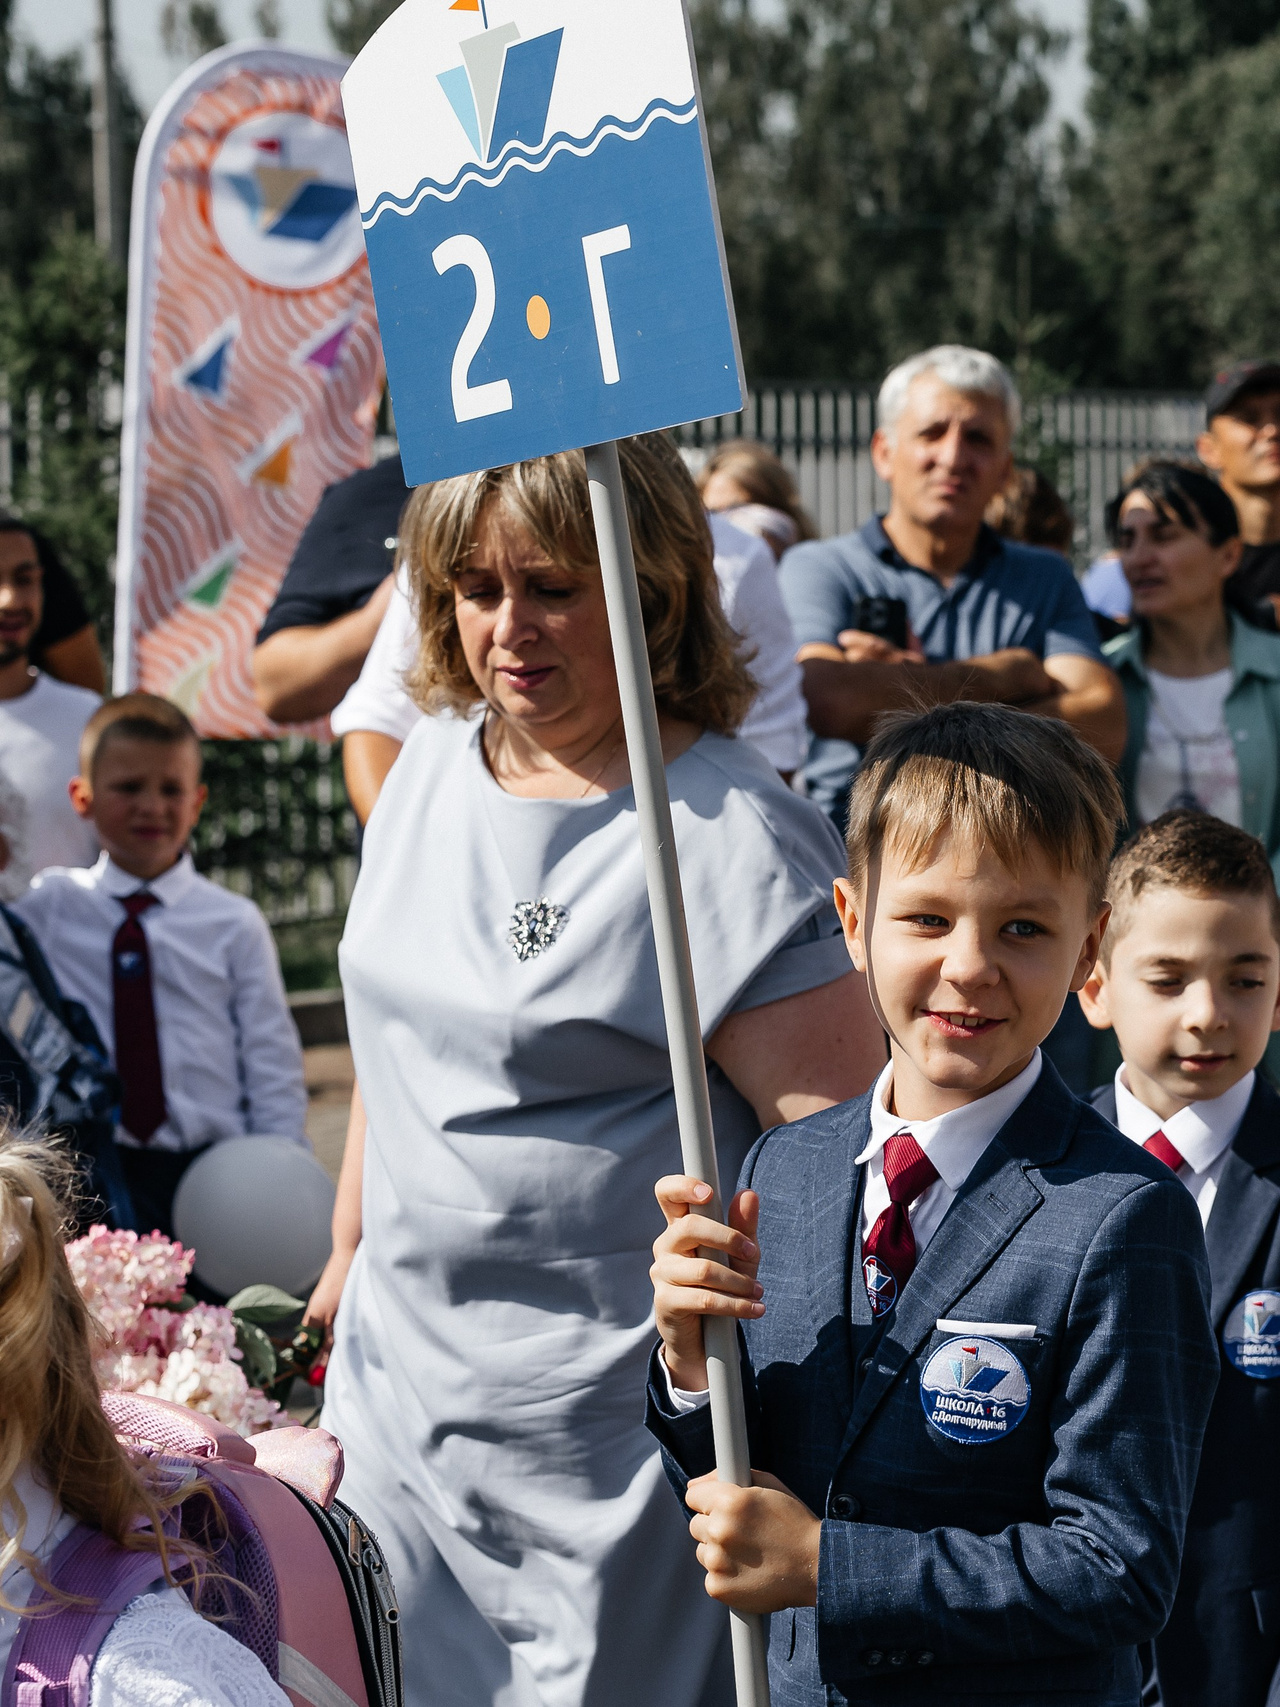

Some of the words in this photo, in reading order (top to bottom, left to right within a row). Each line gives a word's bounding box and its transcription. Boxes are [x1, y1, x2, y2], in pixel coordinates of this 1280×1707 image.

[431, 234, 513, 424] 2
[581, 223, 631, 385] Г
[936, 1395, 985, 1416] ШКОЛА
[990, 1405, 1007, 1418] 16
